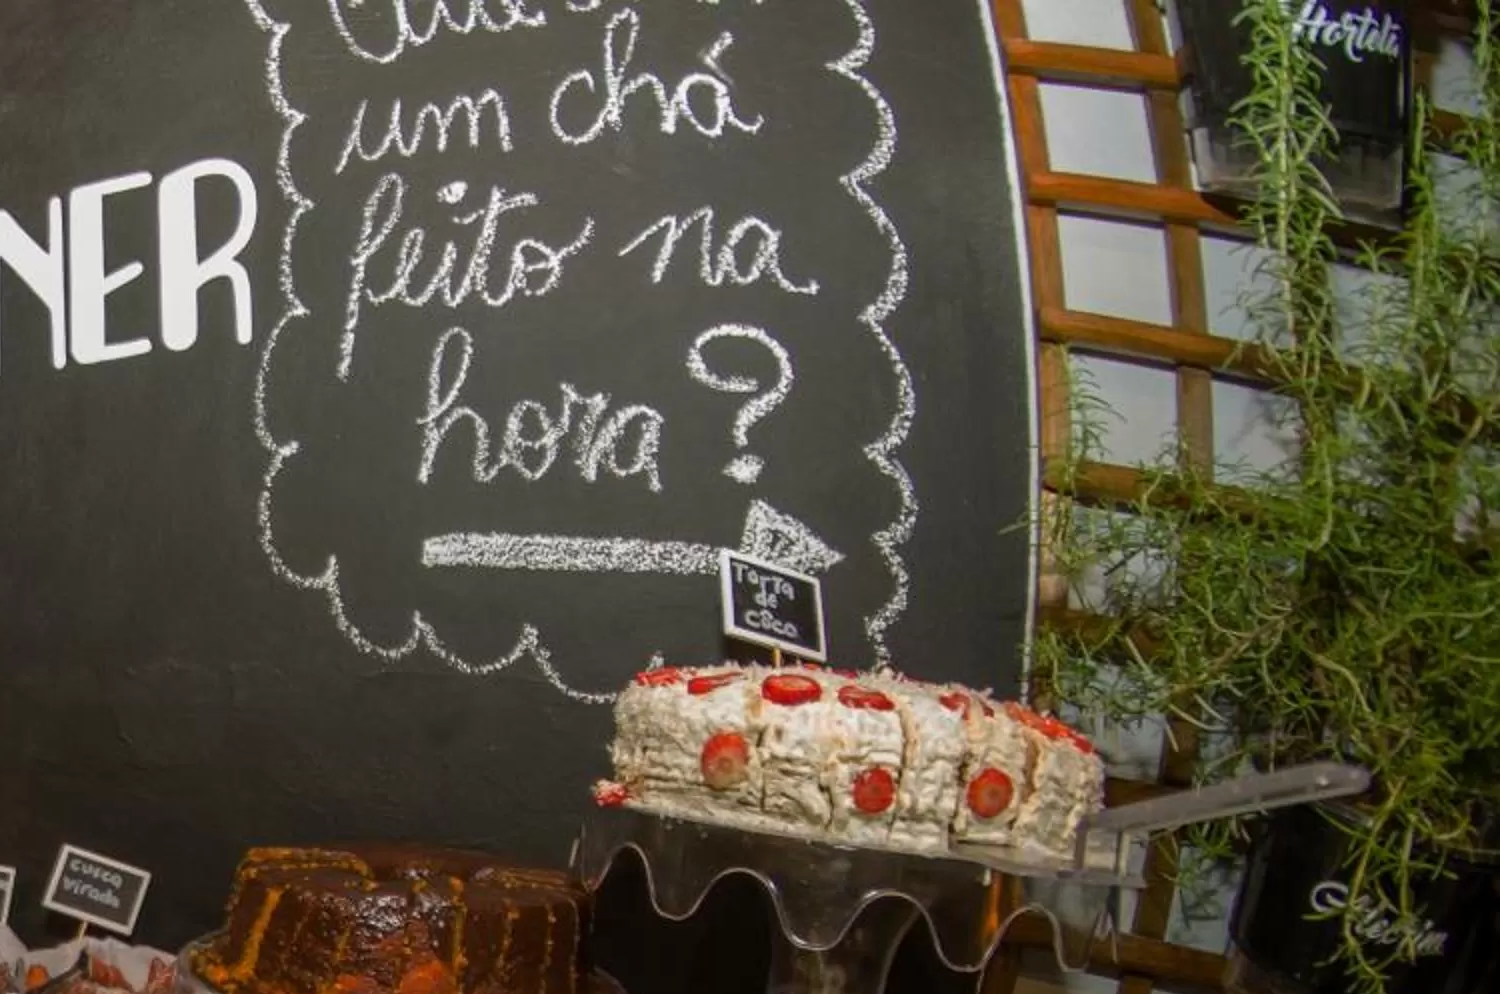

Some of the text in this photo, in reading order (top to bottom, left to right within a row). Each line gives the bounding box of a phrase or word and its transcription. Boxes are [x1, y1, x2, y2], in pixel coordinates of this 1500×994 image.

[336, 88, 512, 174] um
[549, 8, 764, 145] chá
[337, 173, 819, 382] feito na
[417, 326, 664, 492] hora
